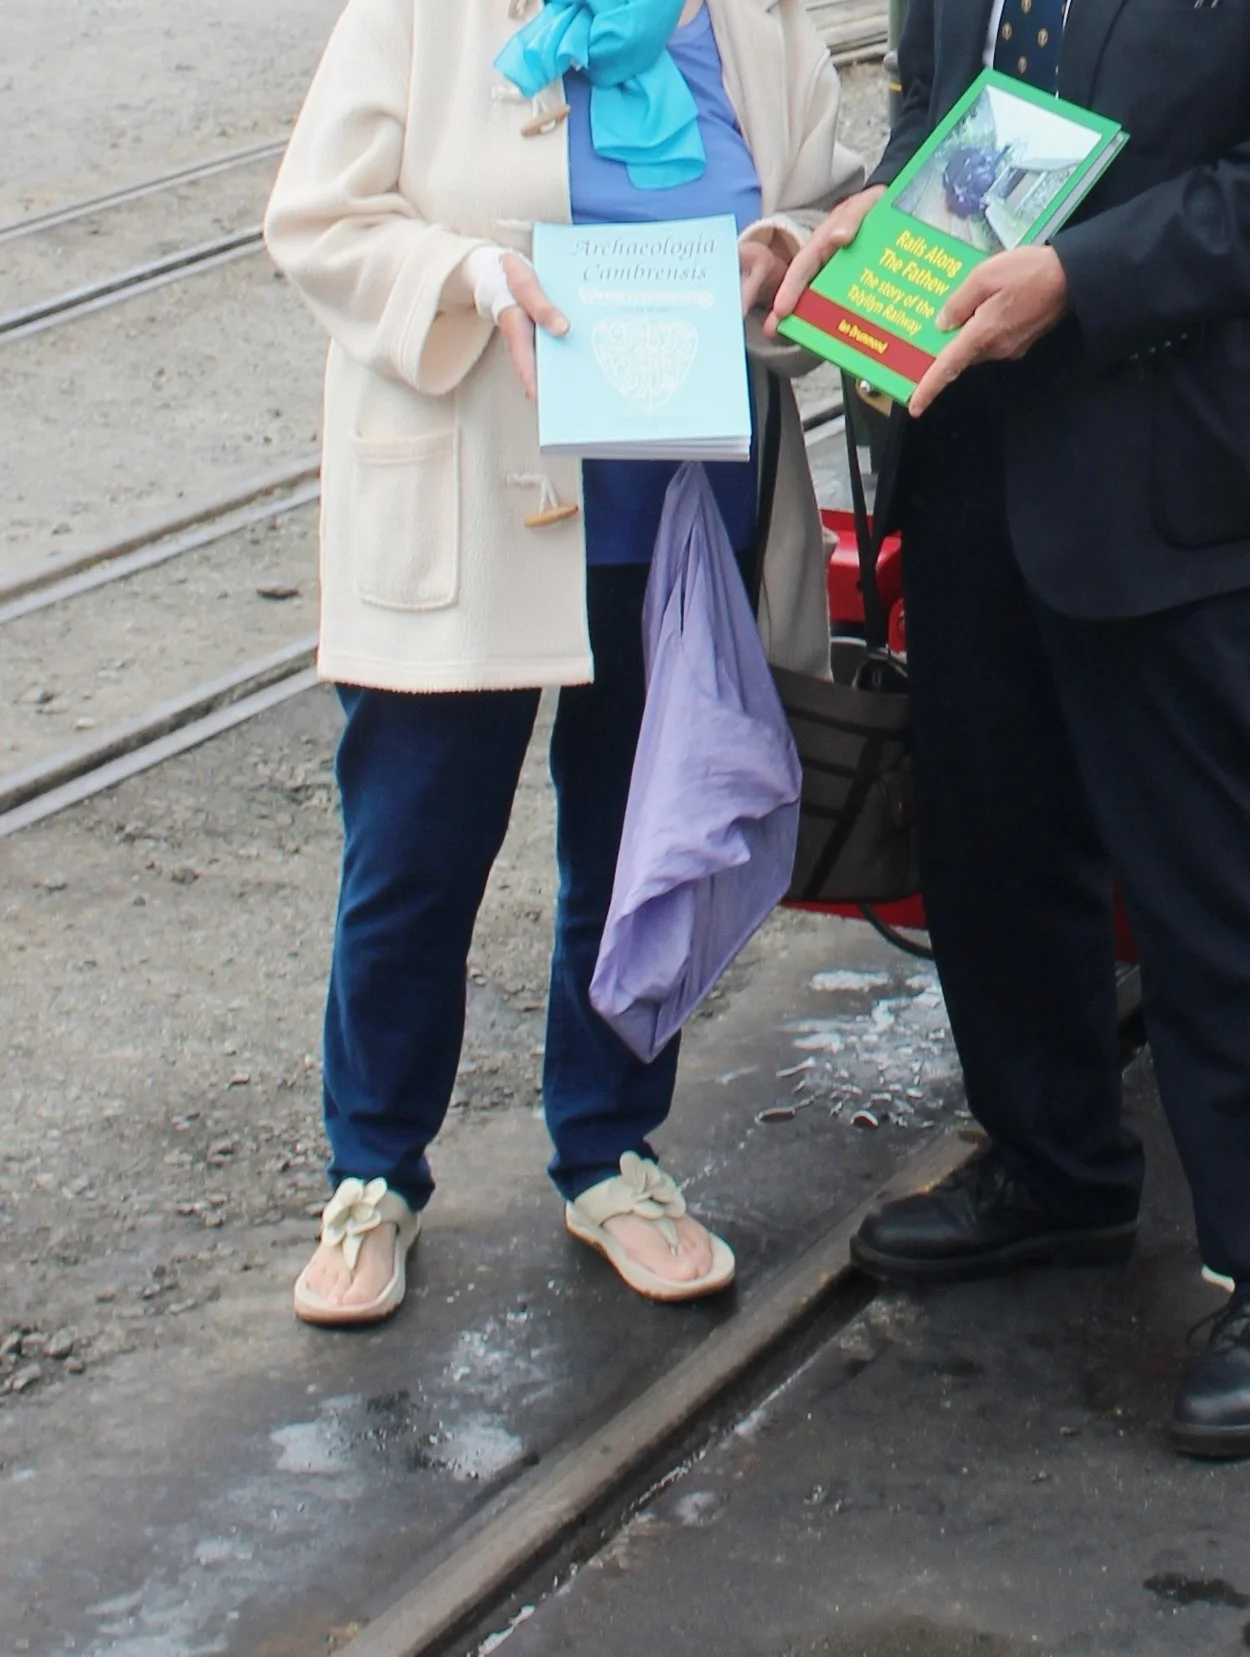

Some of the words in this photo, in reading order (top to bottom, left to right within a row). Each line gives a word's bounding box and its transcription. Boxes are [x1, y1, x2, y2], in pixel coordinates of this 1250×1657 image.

[572, 233, 716, 262] Archaeologia
[895, 229, 927, 258] Rails
[924, 246, 963, 278] Along
[582, 261, 707, 282] Cambrensis
[879, 247, 903, 273] The
[901, 260, 950, 296] Fathew
[860, 267, 880, 289] The
[877, 279, 905, 304] story
[903, 295, 921, 309] of
[915, 299, 936, 319] the
[882, 303, 922, 337] Railway
